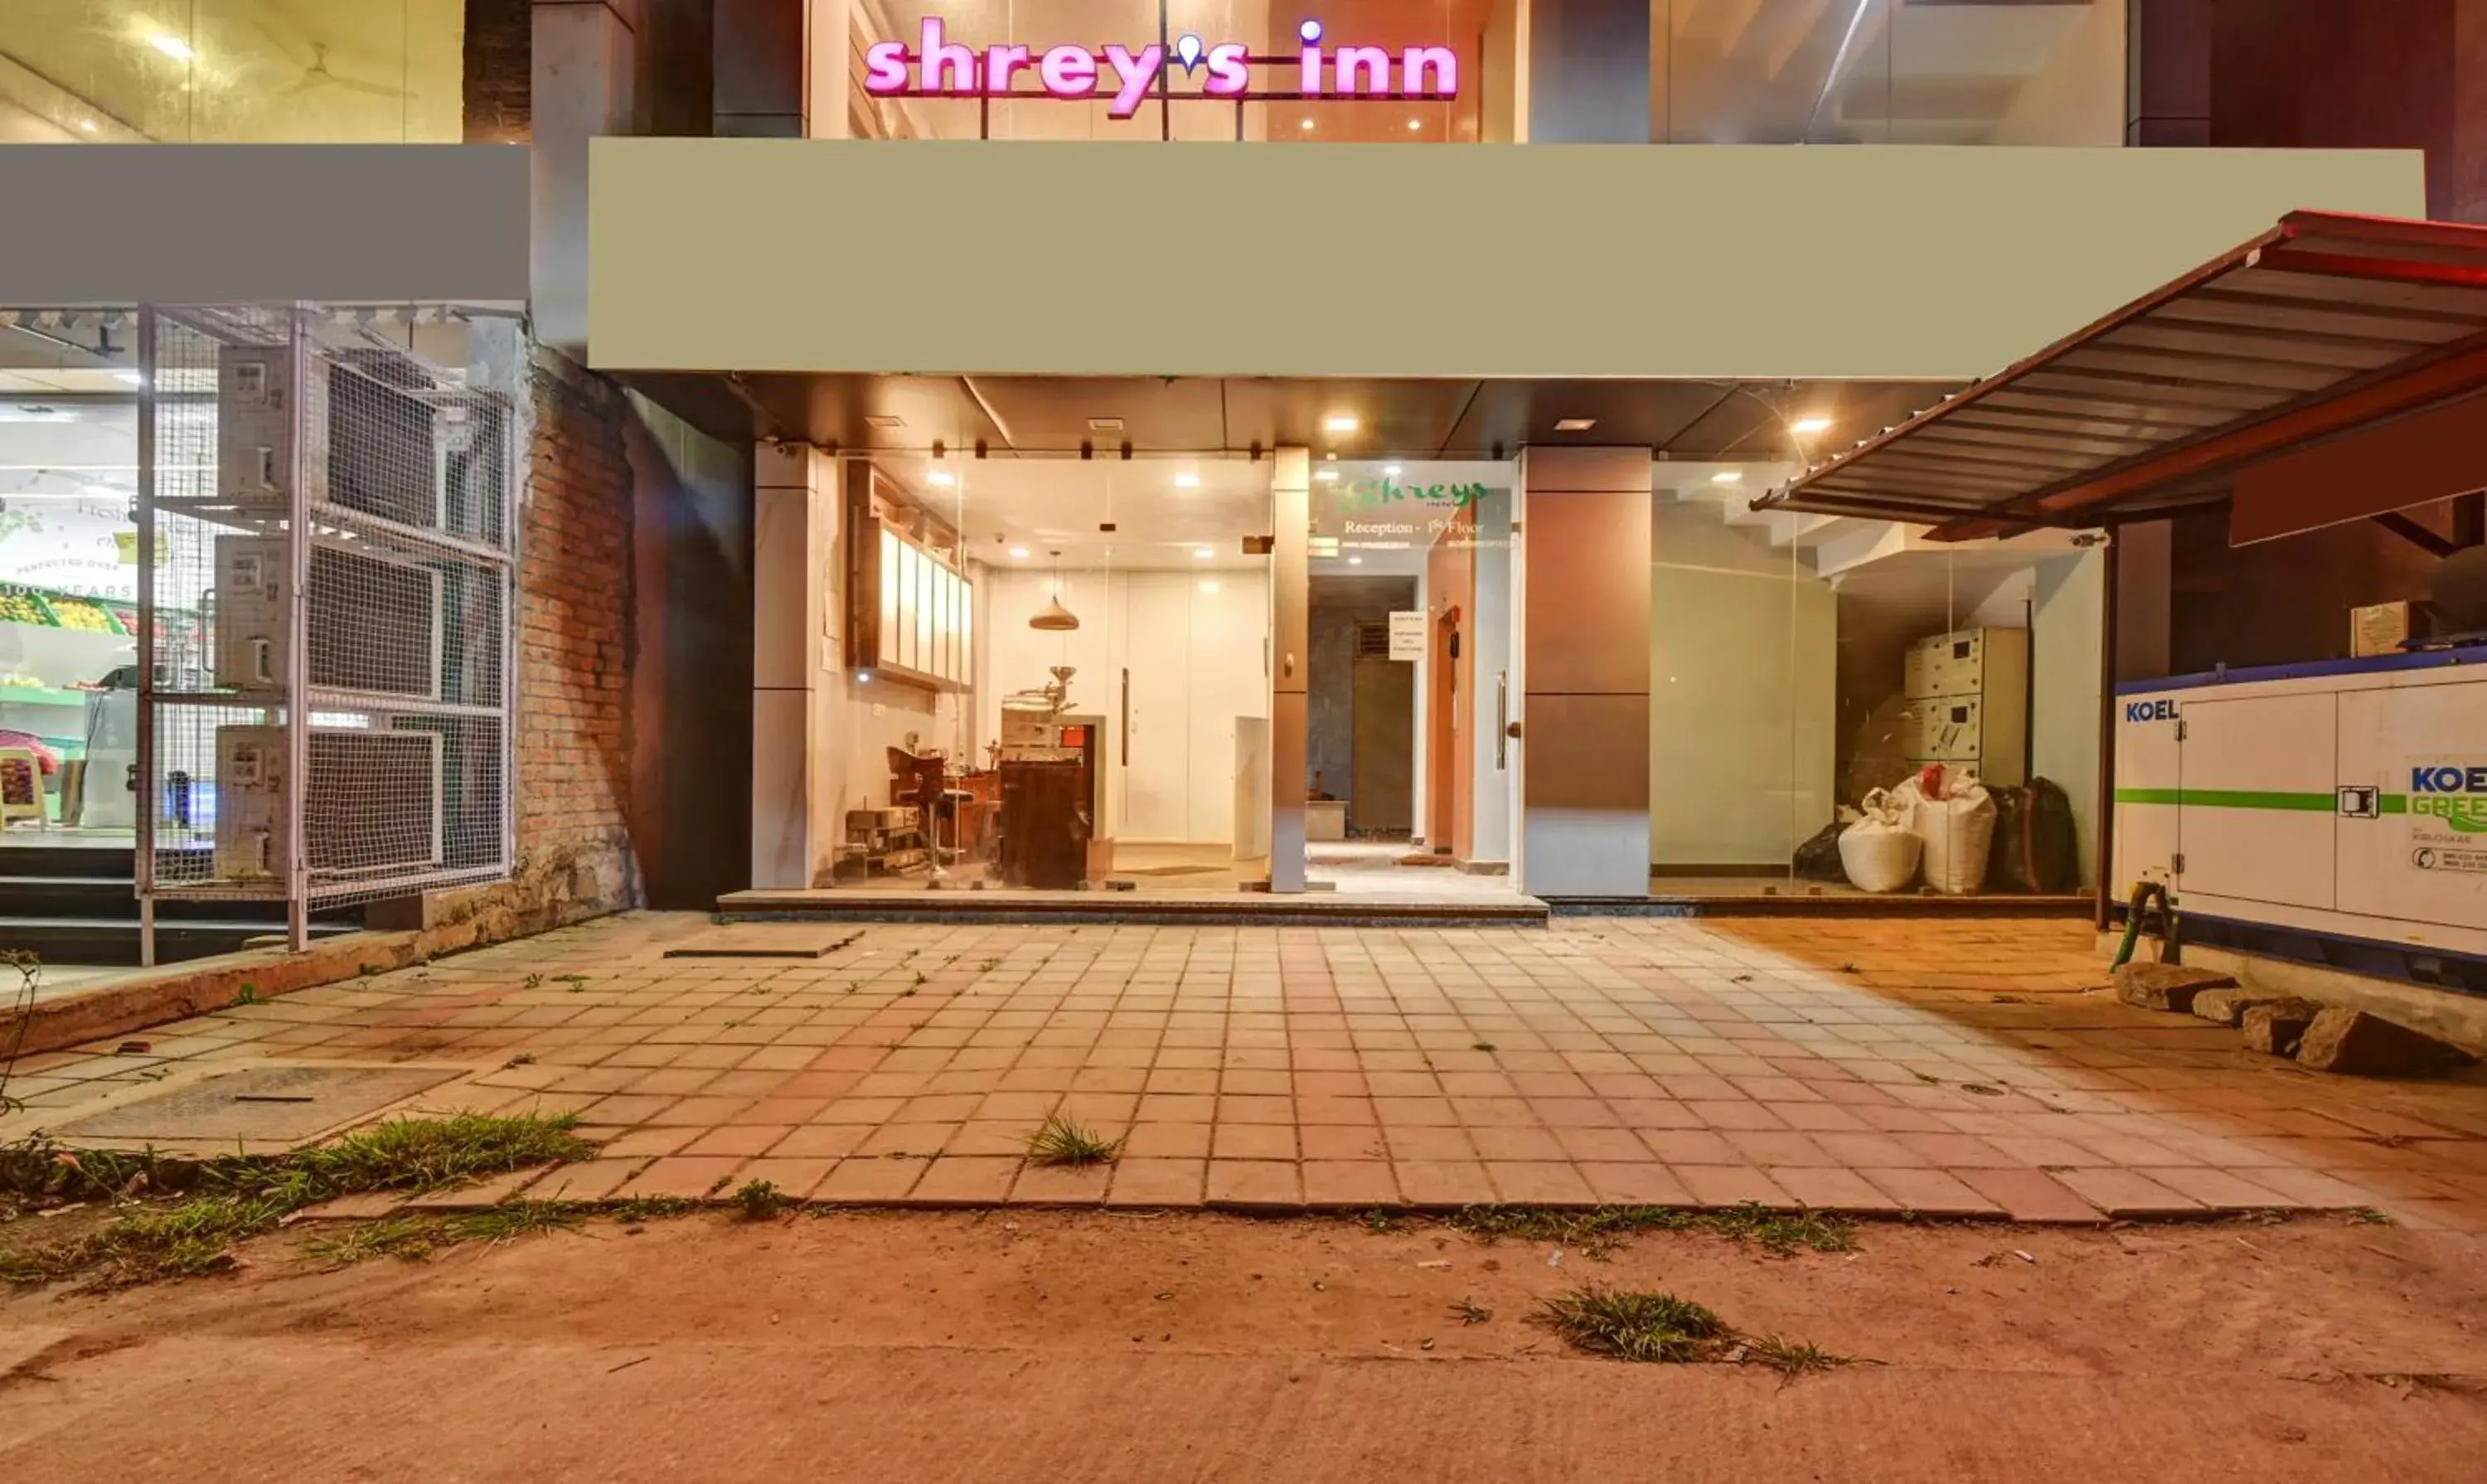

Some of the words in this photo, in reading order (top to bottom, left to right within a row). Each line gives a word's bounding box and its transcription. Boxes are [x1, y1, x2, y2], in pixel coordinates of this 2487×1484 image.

[865, 17, 1249, 119] shrey's
[1299, 20, 1457, 99] inn
[2126, 699, 2179, 723] KOEL
